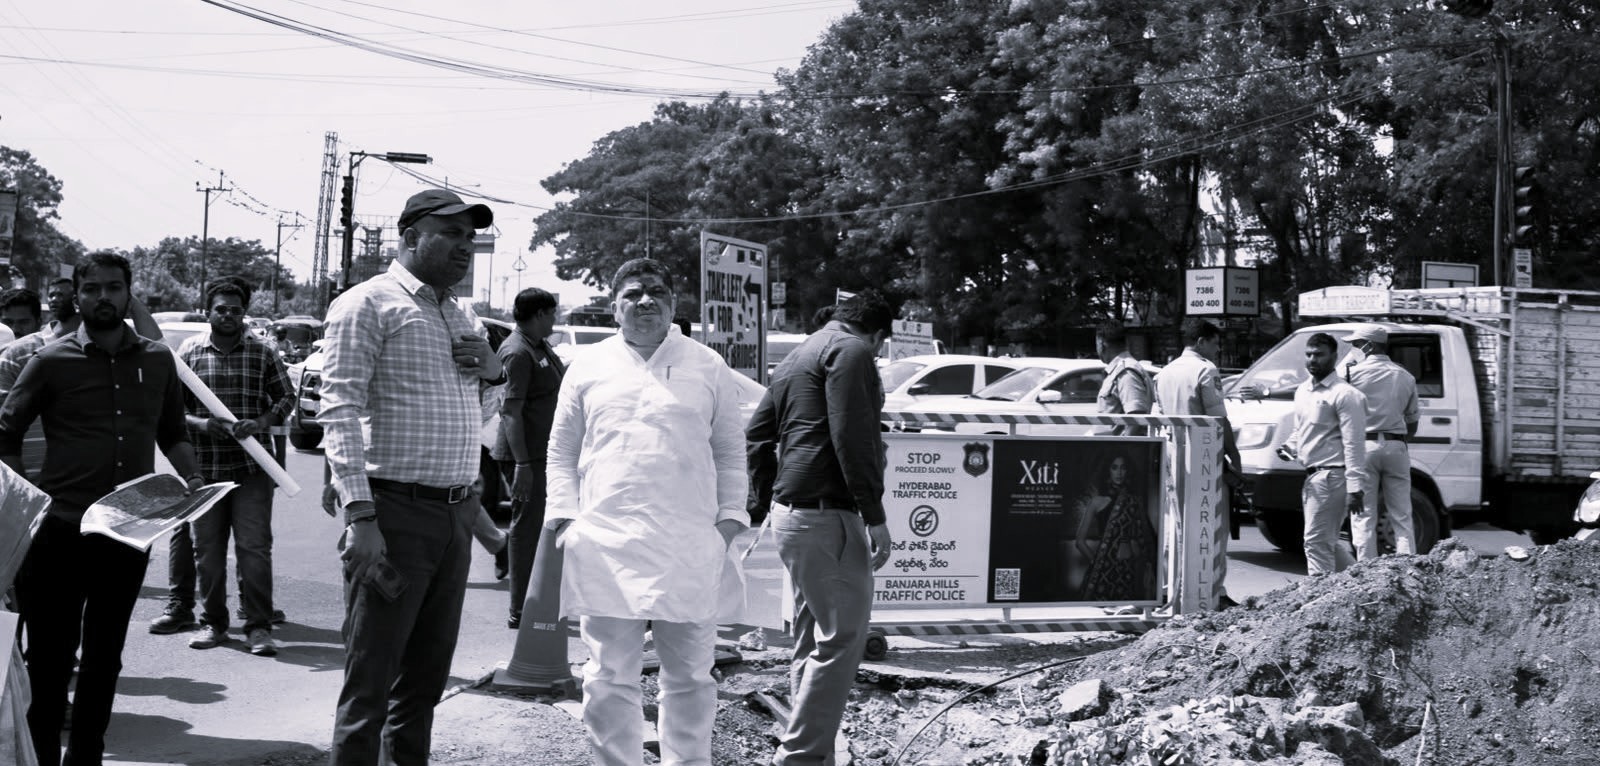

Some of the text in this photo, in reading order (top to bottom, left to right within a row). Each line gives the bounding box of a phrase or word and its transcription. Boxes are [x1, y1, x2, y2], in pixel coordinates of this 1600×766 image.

[707, 270, 725, 302] TAKE
[727, 273, 743, 303] LEFT
[717, 305, 733, 333] FOR
[907, 452, 941, 464] STOP
[928, 466, 956, 474] SLOWLY
[899, 482, 952, 490] HYDERABAD
[892, 490, 958, 499] TRAFFIC POLICE
[885, 580, 959, 589] BANJARA HILLS
[875, 591, 966, 601] TRAFFIC POLICE
